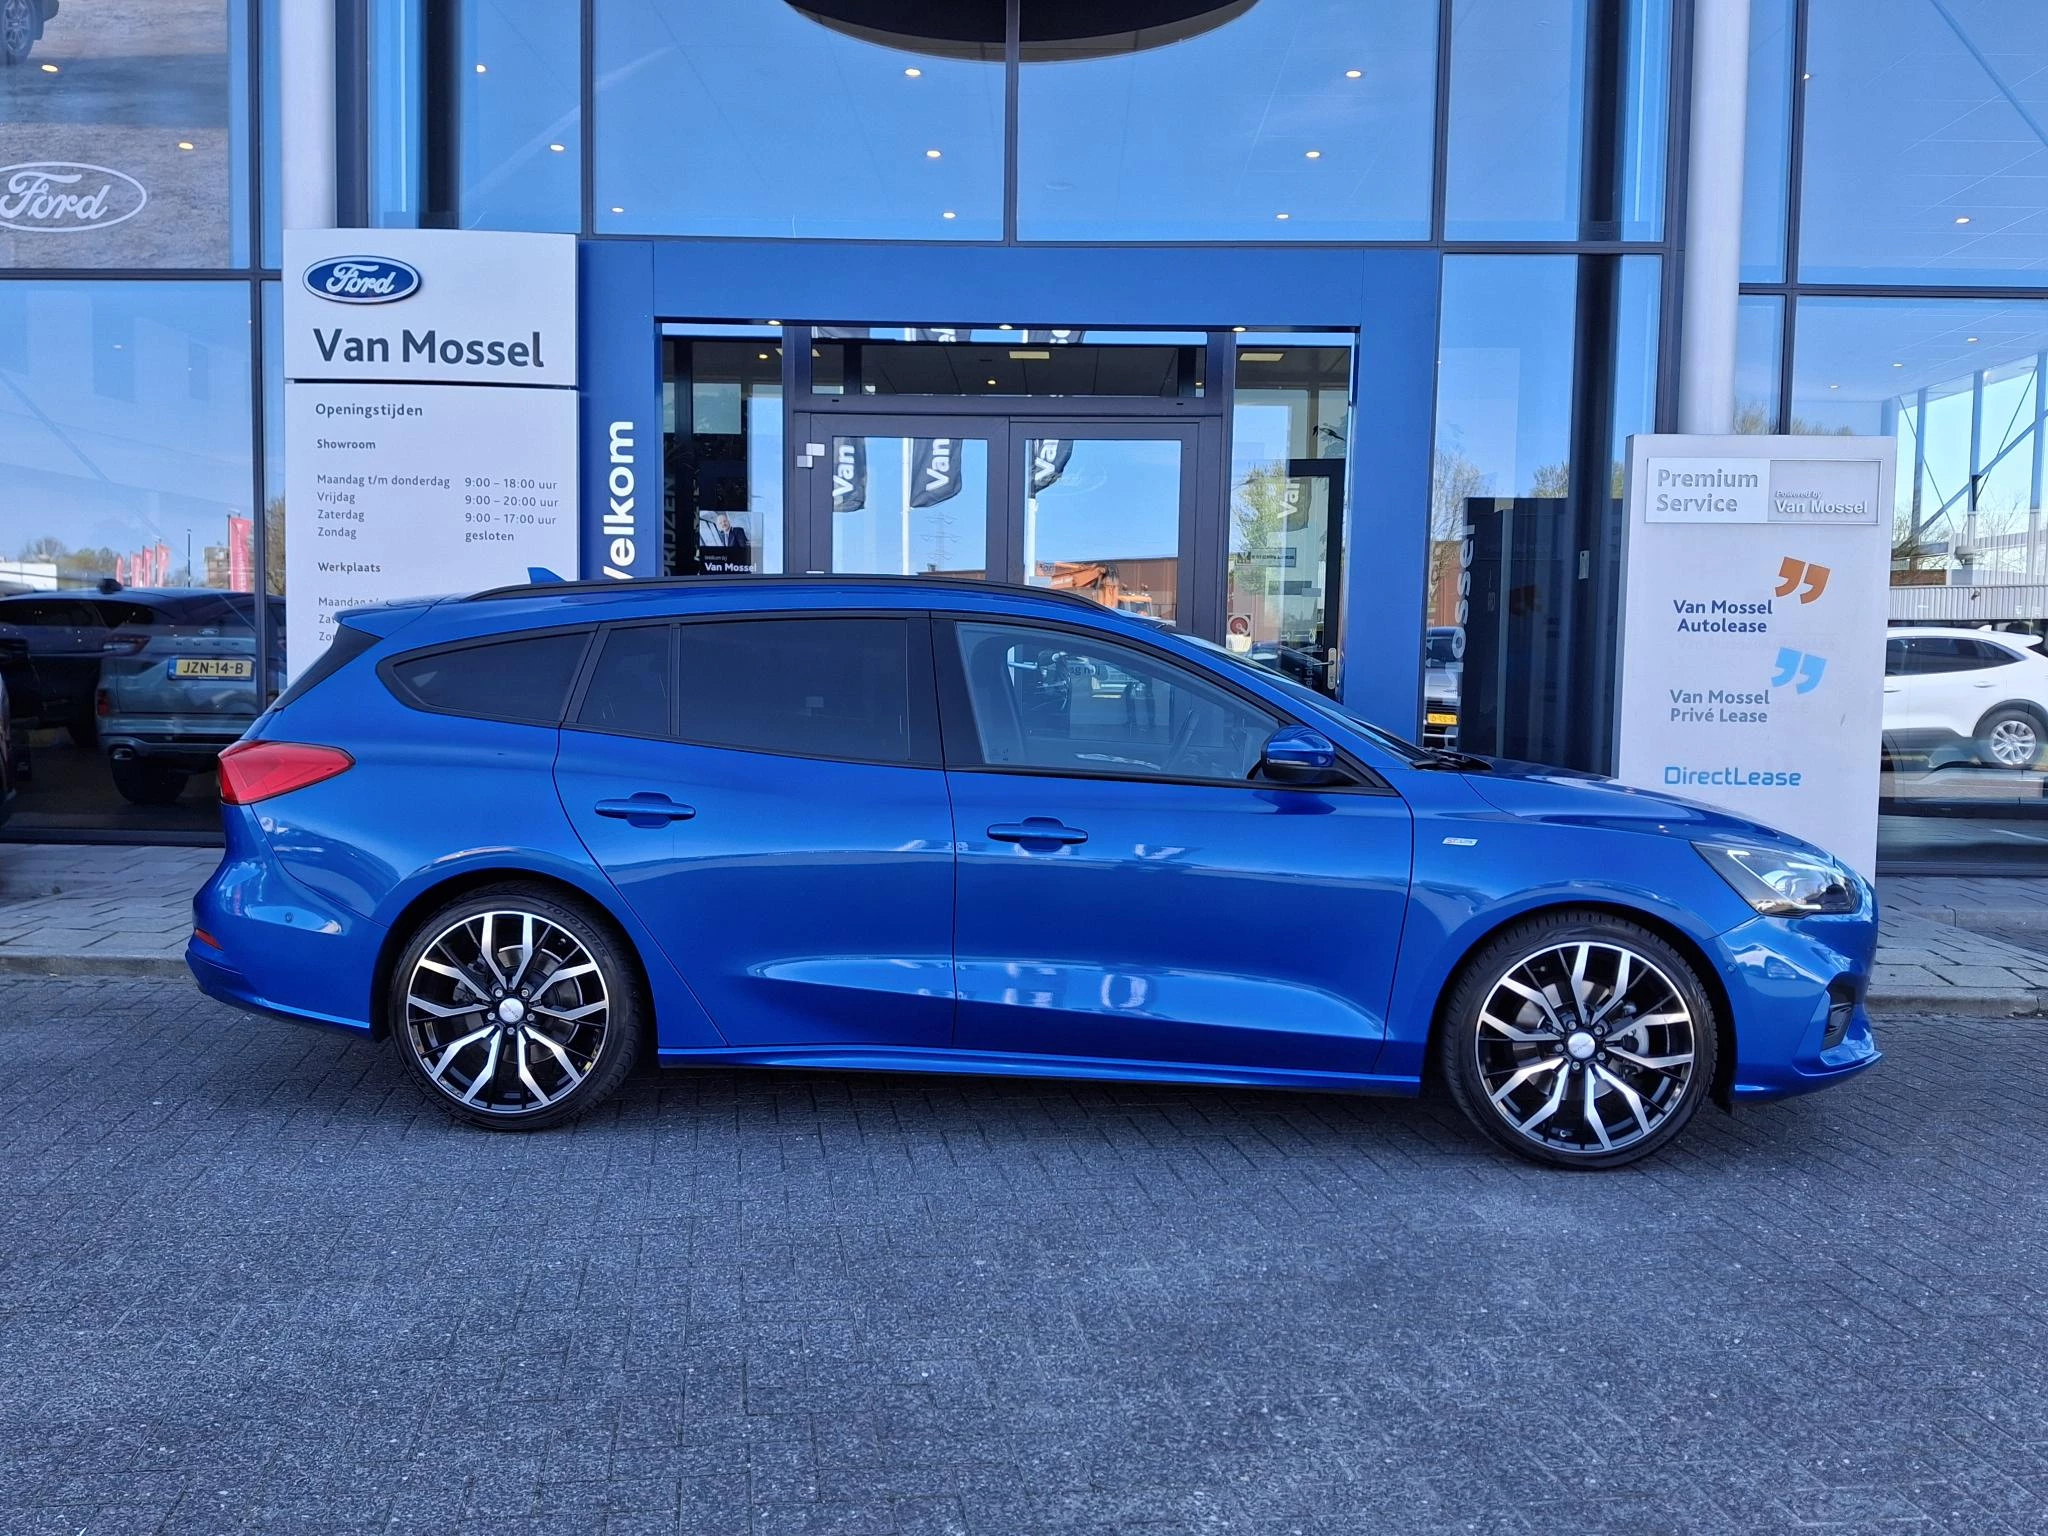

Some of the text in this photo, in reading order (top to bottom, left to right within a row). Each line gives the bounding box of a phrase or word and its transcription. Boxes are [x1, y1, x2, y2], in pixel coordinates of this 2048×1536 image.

[0, 171, 111, 219] Ford
[312, 328, 545, 368] Van Mossel
[315, 403, 424, 419] Openingstijden
[317, 438, 377, 450] Showroom
[317, 474, 451, 489] Maandag t/m donderdag
[465, 477, 491, 488] 9:00
[503, 478, 536, 489] 18:00
[538, 481, 558, 489] uur
[1656, 468, 1760, 488] Premium
[317, 491, 356, 505] Vrijdag
[465, 494, 491, 505] 9:00
[503, 496, 537, 507] 20:00
[539, 499, 560, 507] uur
[603, 421, 636, 580] elkom
[1655, 493, 1739, 513] Service
[1774, 499, 1869, 515] Van Mossel
[317, 509, 366, 523] Zaterdag
[465, 512, 491, 523] 9:00
[503, 513, 535, 525] 17:00
[537, 517, 557, 525] uur
[317, 526, 358, 540] Zondag
[465, 531, 515, 543] gesloten
[317, 561, 382, 574] Werkplaats
[704, 562, 722, 572] Van
[1673, 600, 1774, 615] Van Mossel
[1676, 618, 1768, 633] Autolease
[182, 661, 244, 675] JZN-14-B
[1669, 689, 1771, 705] Van Mossel
[1670, 708, 1769, 723] Privé Lease
[1664, 766, 1802, 787] DirectLease
